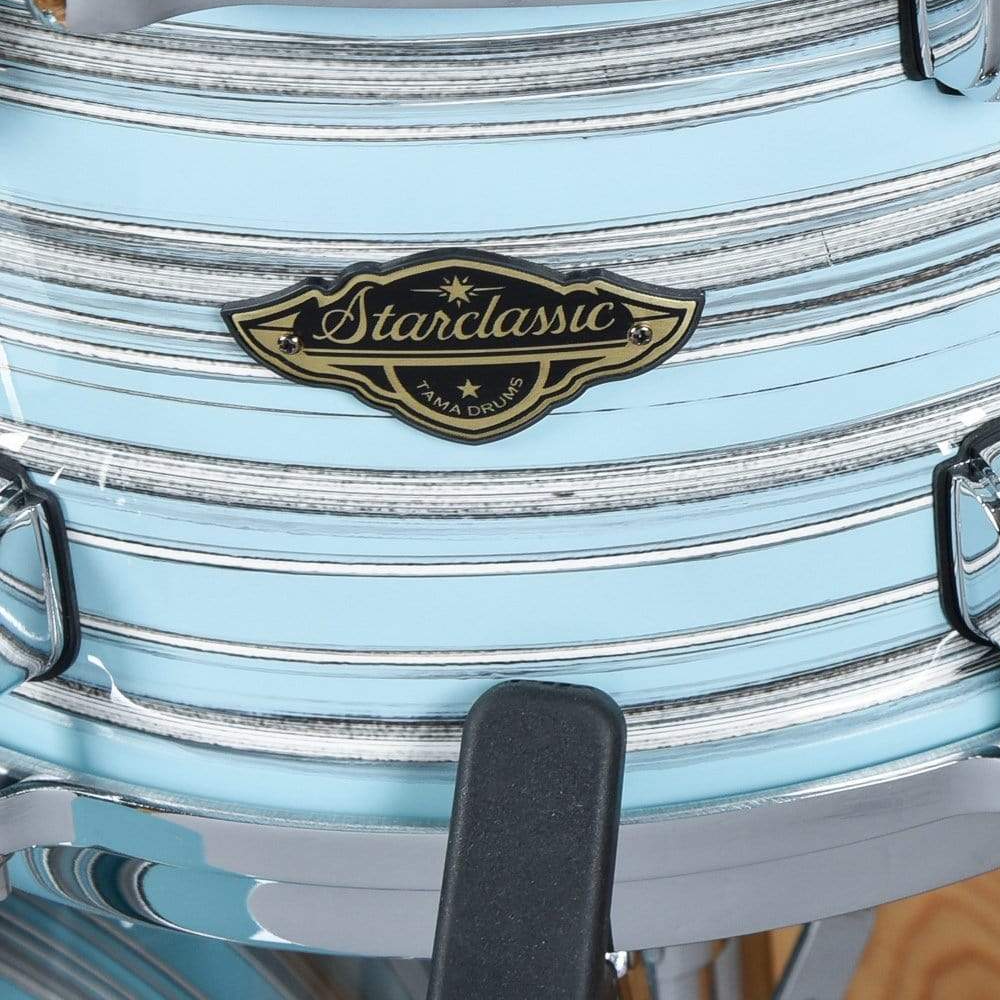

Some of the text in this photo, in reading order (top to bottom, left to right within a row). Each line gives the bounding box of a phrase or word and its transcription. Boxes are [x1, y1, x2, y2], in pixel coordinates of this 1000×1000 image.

[312, 286, 615, 344] Starclassic
[417, 377, 524, 416] TAMA DRUMS
